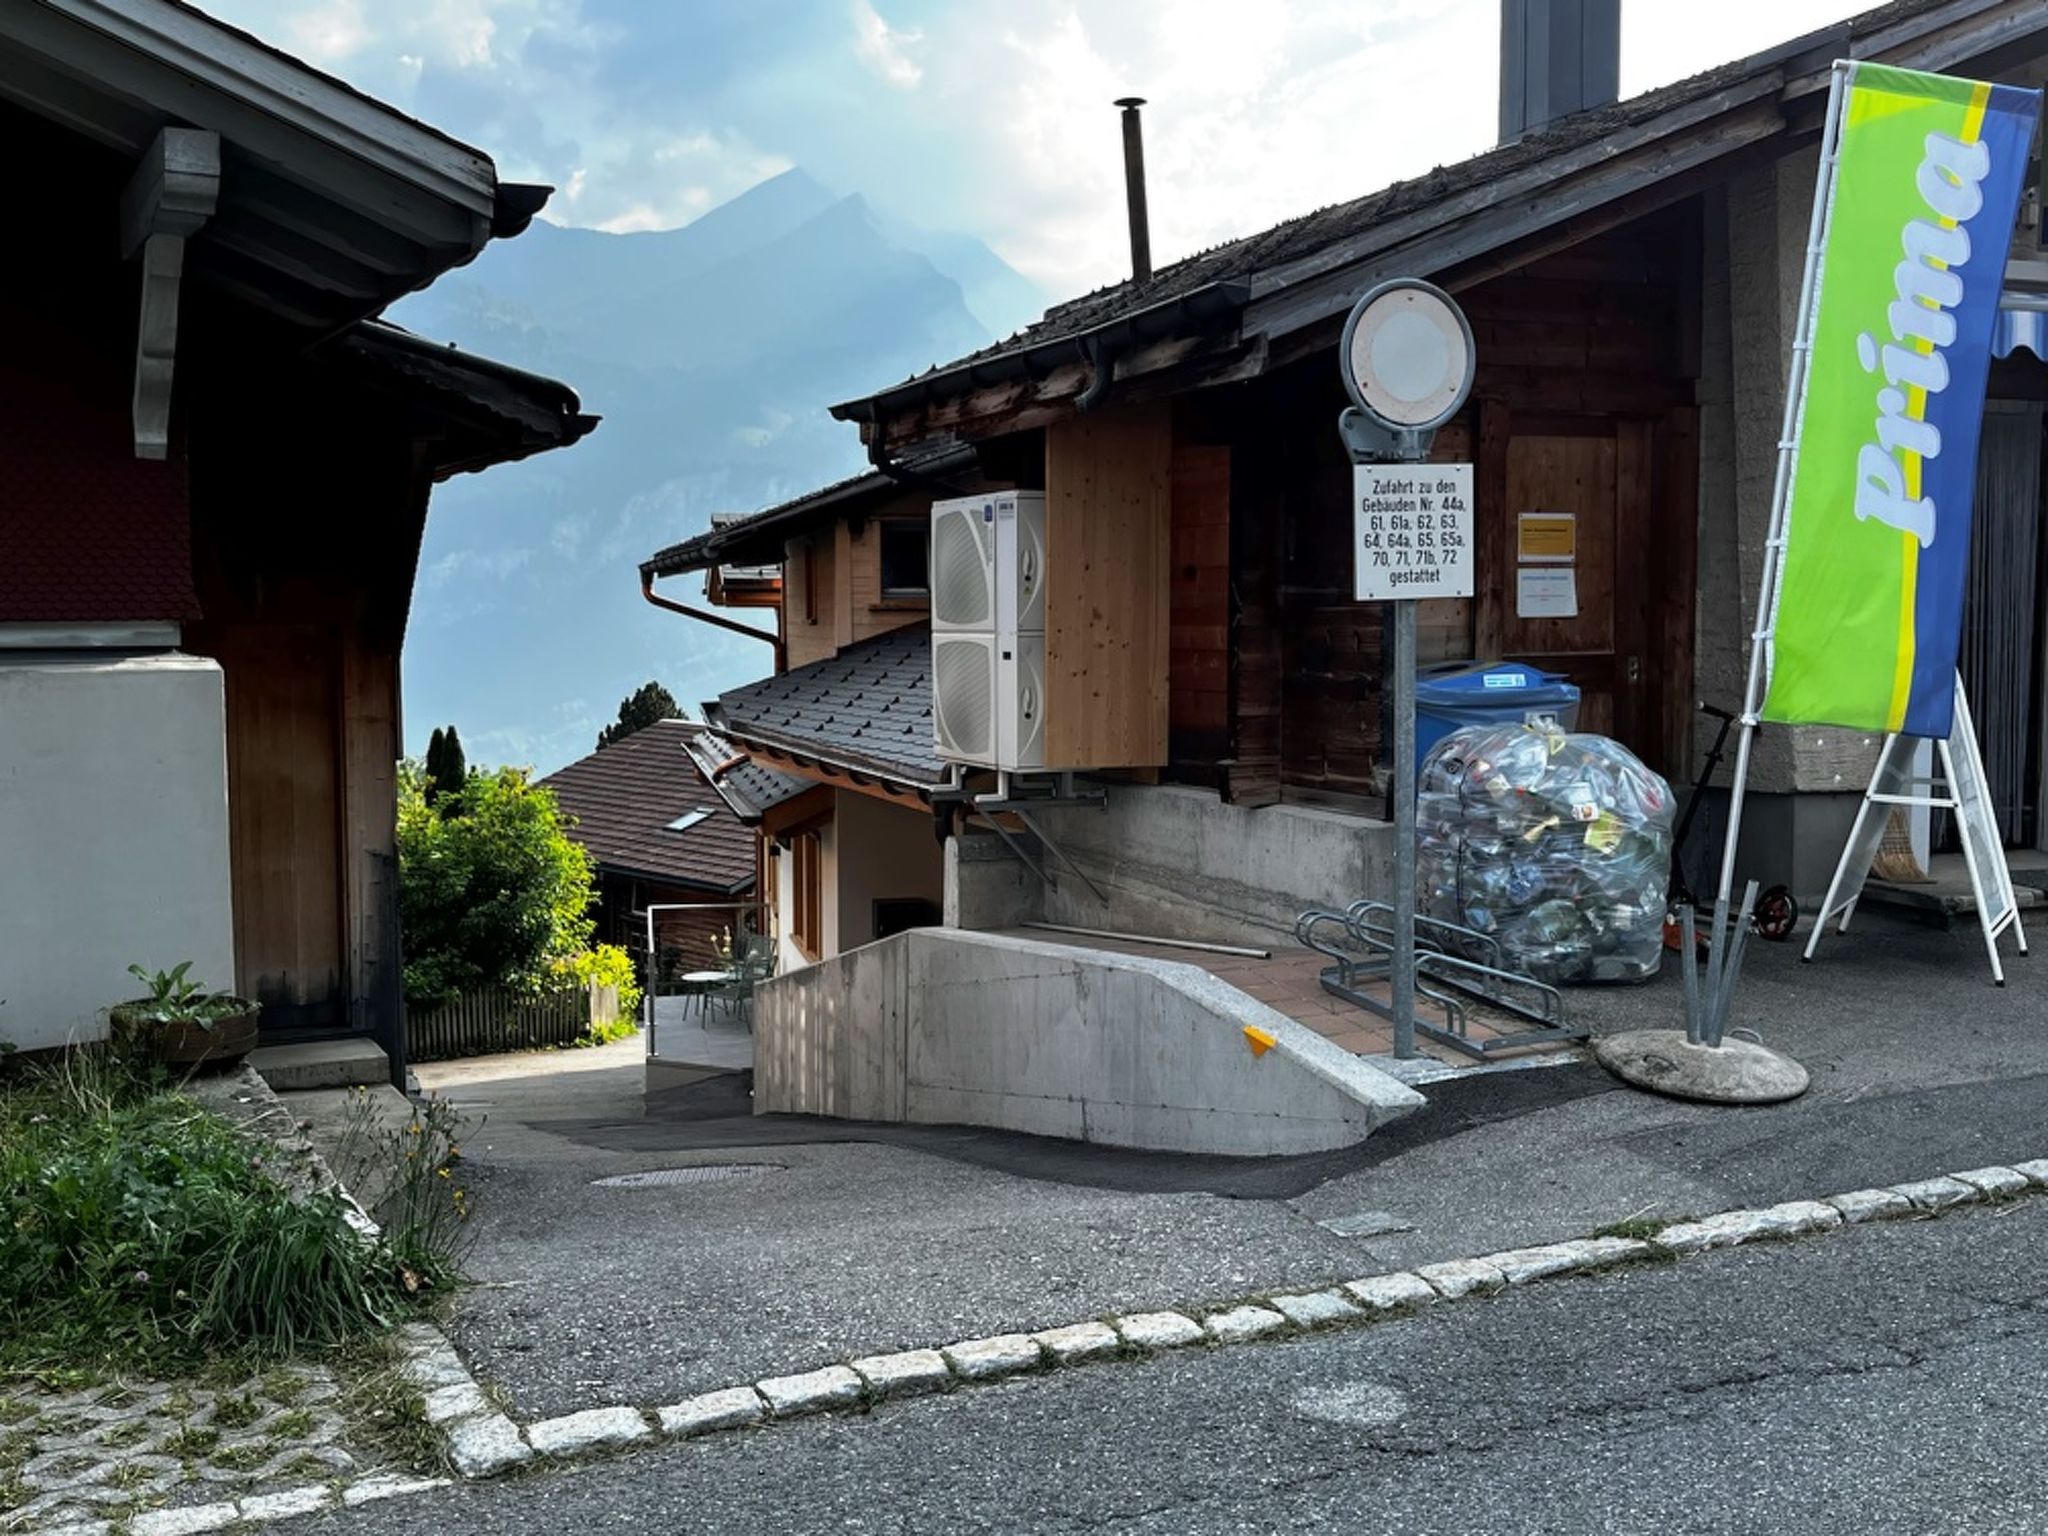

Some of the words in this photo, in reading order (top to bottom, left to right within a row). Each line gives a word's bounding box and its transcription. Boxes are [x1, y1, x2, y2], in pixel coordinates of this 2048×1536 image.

[1854, 131, 1990, 549] Prima
[1373, 480, 1413, 494] Zufahrt
[1419, 482, 1432, 494] zu
[1436, 479, 1456, 493] den
[1362, 497, 1416, 512] Gebäuden
[1420, 497, 1435, 511] Nr.
[1442, 496, 1466, 511] 44a,
[1371, 515, 1386, 531] 61,
[1391, 515, 1412, 531] 61a,
[1418, 514, 1435, 530] 62,
[1440, 514, 1459, 529] 63,
[1364, 532, 1382, 549] 64,
[1388, 532, 1412, 549] 64a,
[1418, 532, 1435, 548] 65,
[1440, 531, 1465, 547] 65a,
[1373, 550, 1390, 567] 70,
[1396, 550, 1410, 566] 71,
[1416, 550, 1437, 565] 71b,
[1442, 549, 1457, 564] 72
[1389, 568, 1440, 587] gestattet
